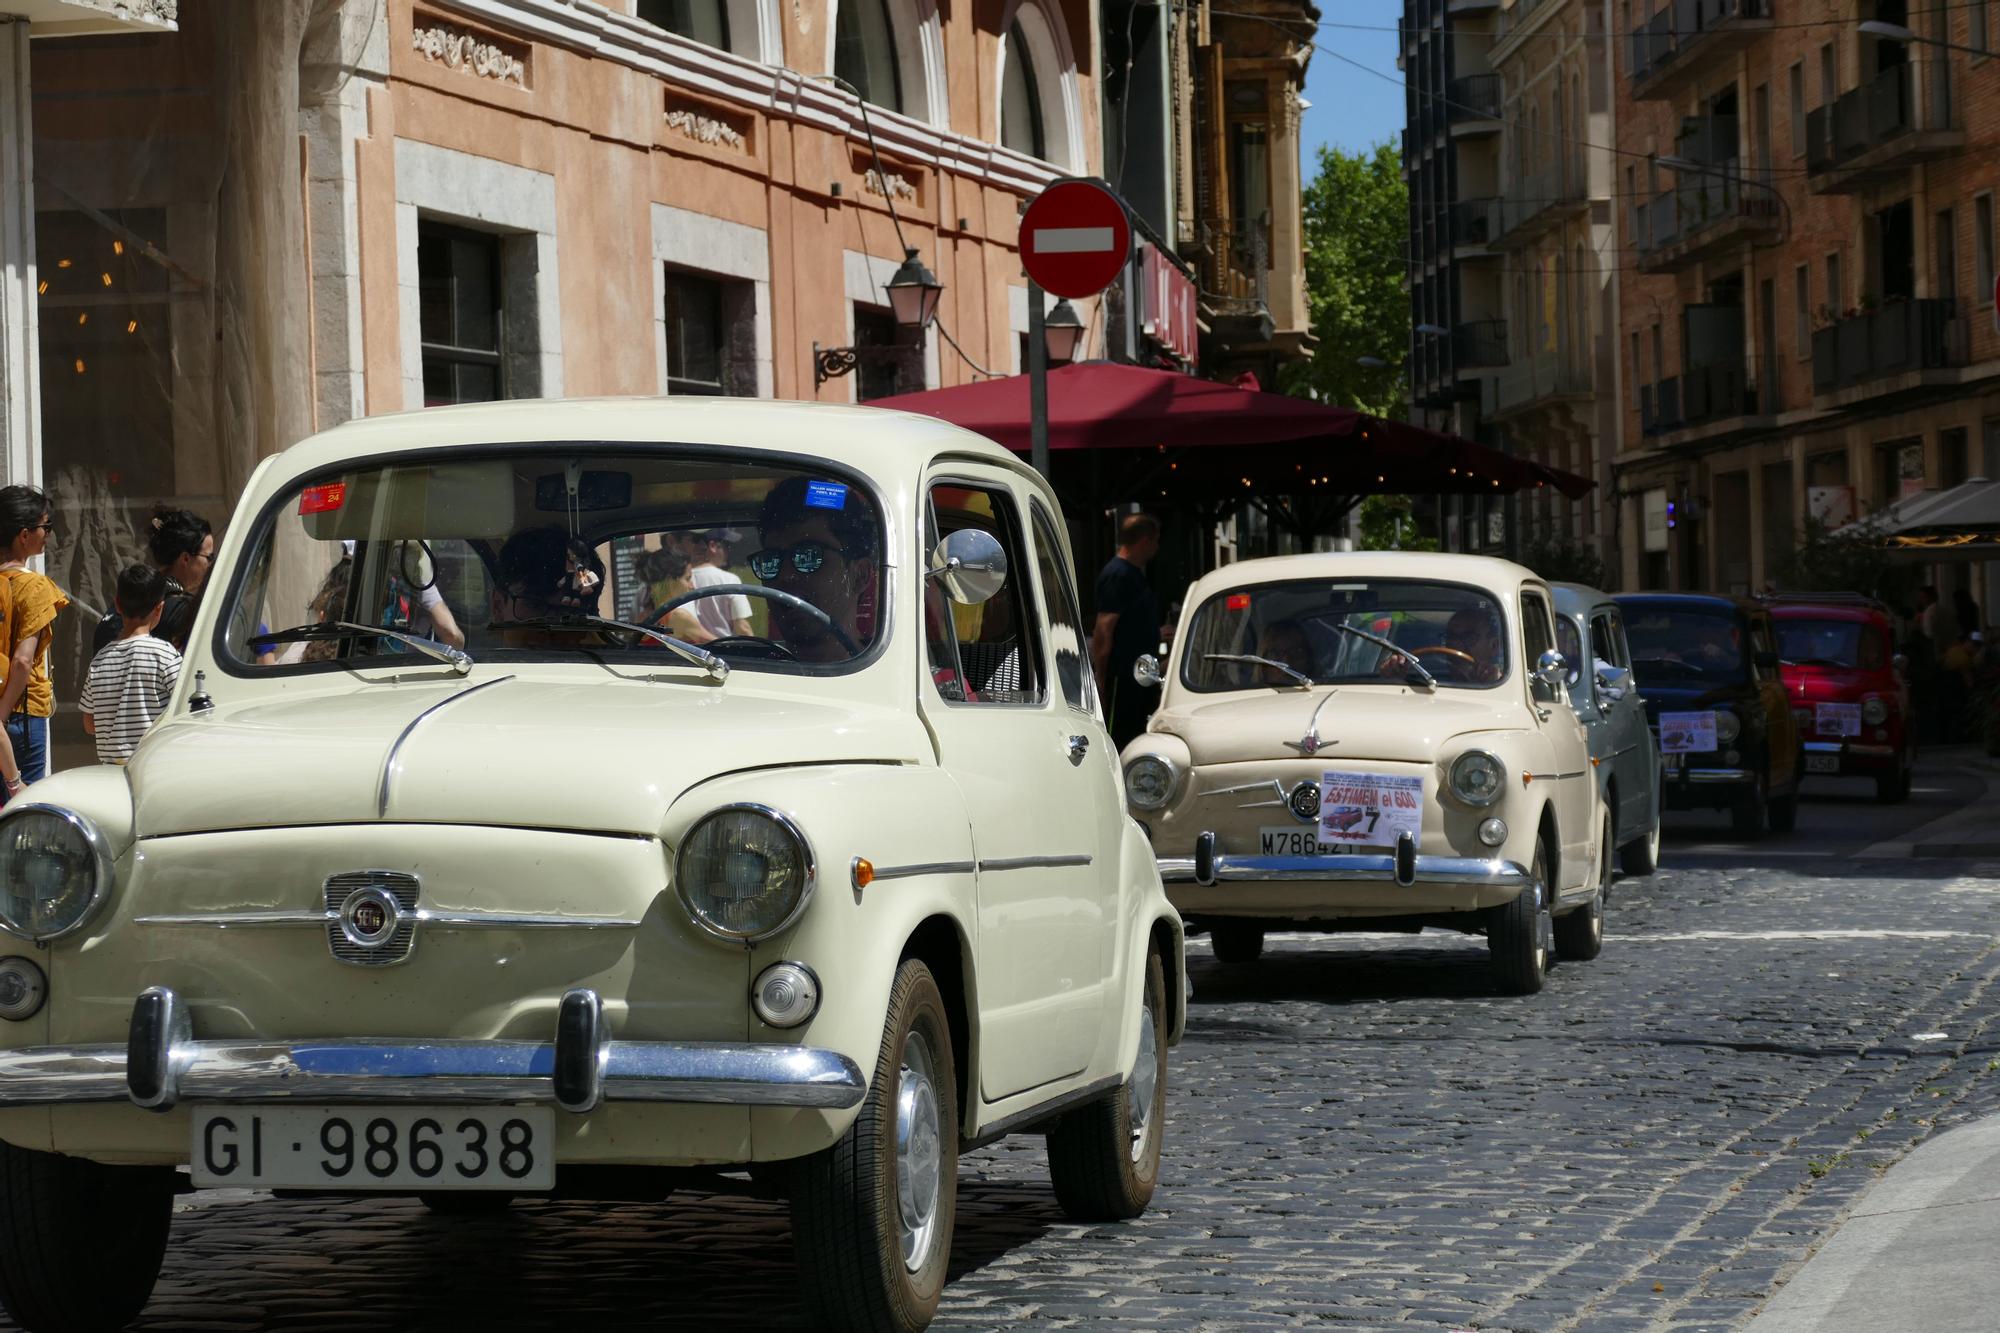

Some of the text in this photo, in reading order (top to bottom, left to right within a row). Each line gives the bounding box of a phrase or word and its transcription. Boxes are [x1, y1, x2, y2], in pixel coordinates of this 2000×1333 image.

[328, 494, 339, 503] 24
[1324, 787, 1379, 806] ESTIMEM
[1382, 791, 1392, 807] el
[1394, 791, 1417, 809] 600
[1365, 811, 1380, 833] 7
[204, 1116, 262, 1177] GI
[319, 1117, 534, 1178] 98638
